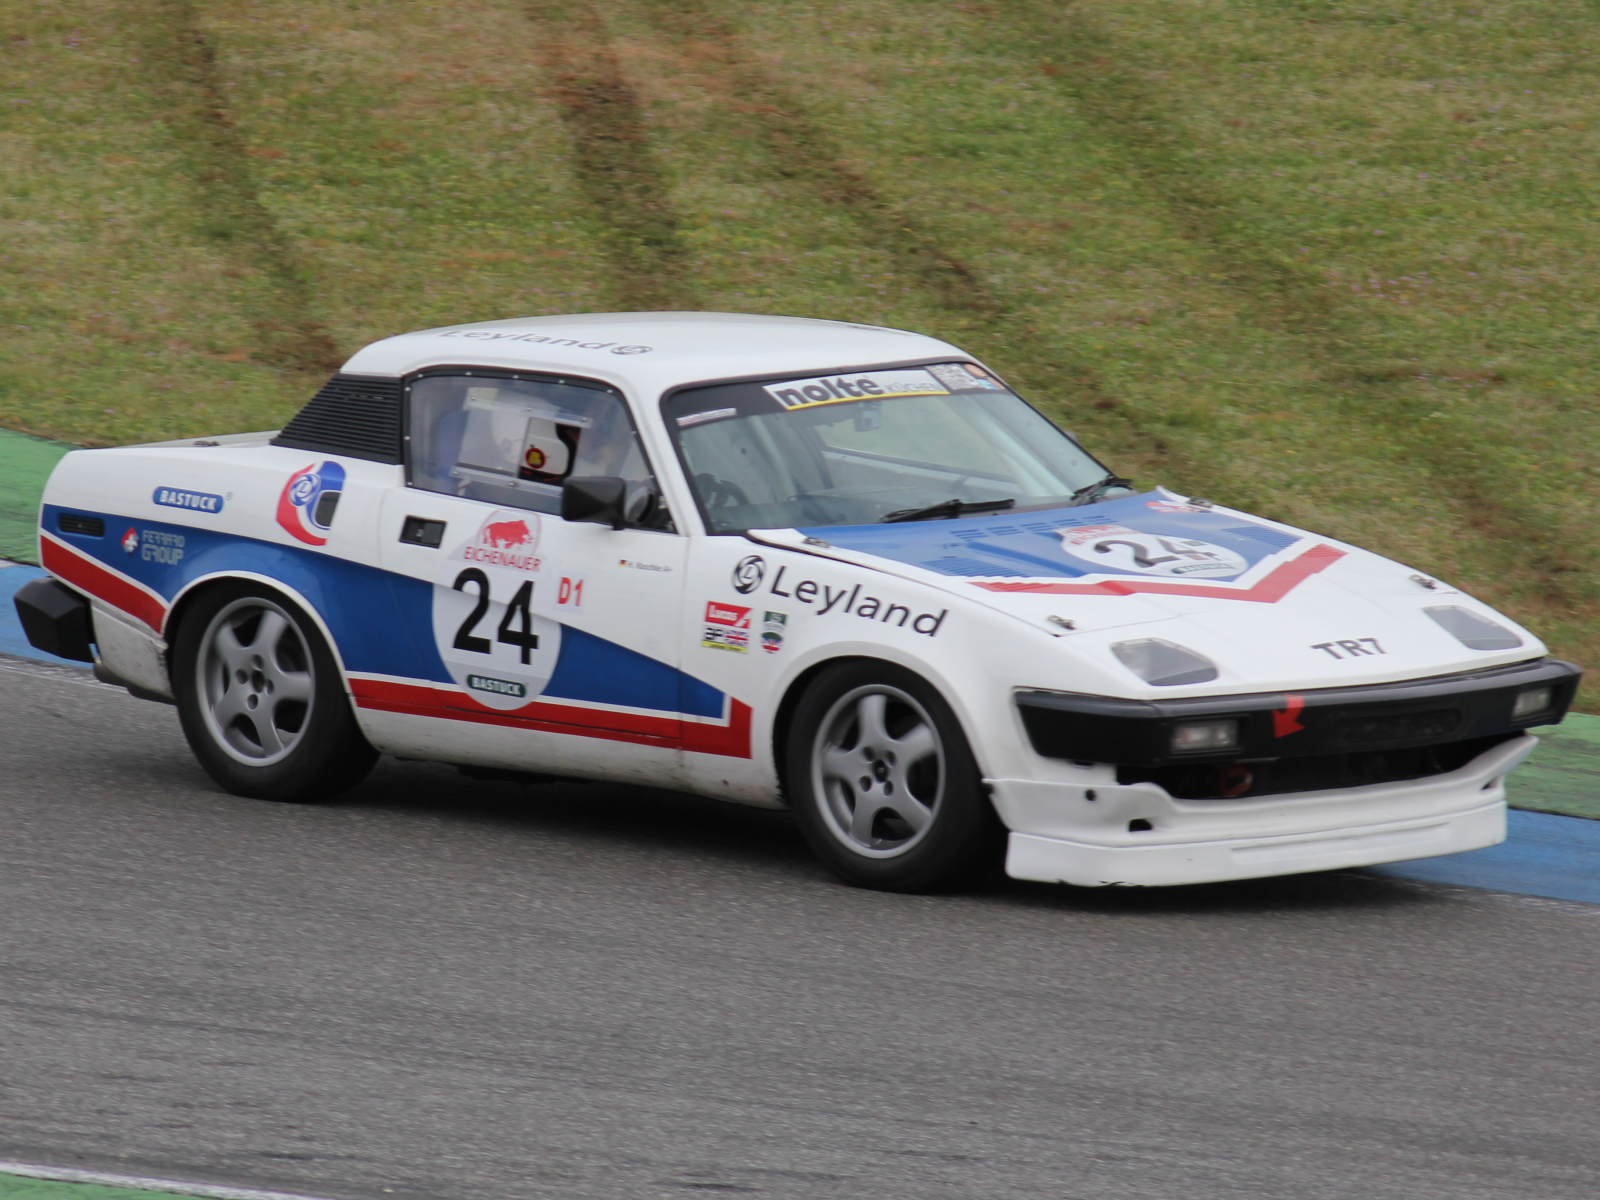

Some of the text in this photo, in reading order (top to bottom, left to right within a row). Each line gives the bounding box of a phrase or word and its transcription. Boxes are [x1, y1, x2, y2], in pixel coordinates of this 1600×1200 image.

[438, 331, 619, 350] Leyland
[775, 377, 884, 406] nolte
[159, 490, 217, 511] BASTUCK
[142, 544, 184, 566] GROUP
[464, 546, 541, 572] EICHENAUER
[1094, 538, 1223, 568] 24
[557, 577, 584, 606] D1
[769, 565, 949, 637] Leyland
[453, 567, 539, 665] 24
[1310, 637, 1388, 660] TR7
[472, 676, 522, 696] BASTUCK
